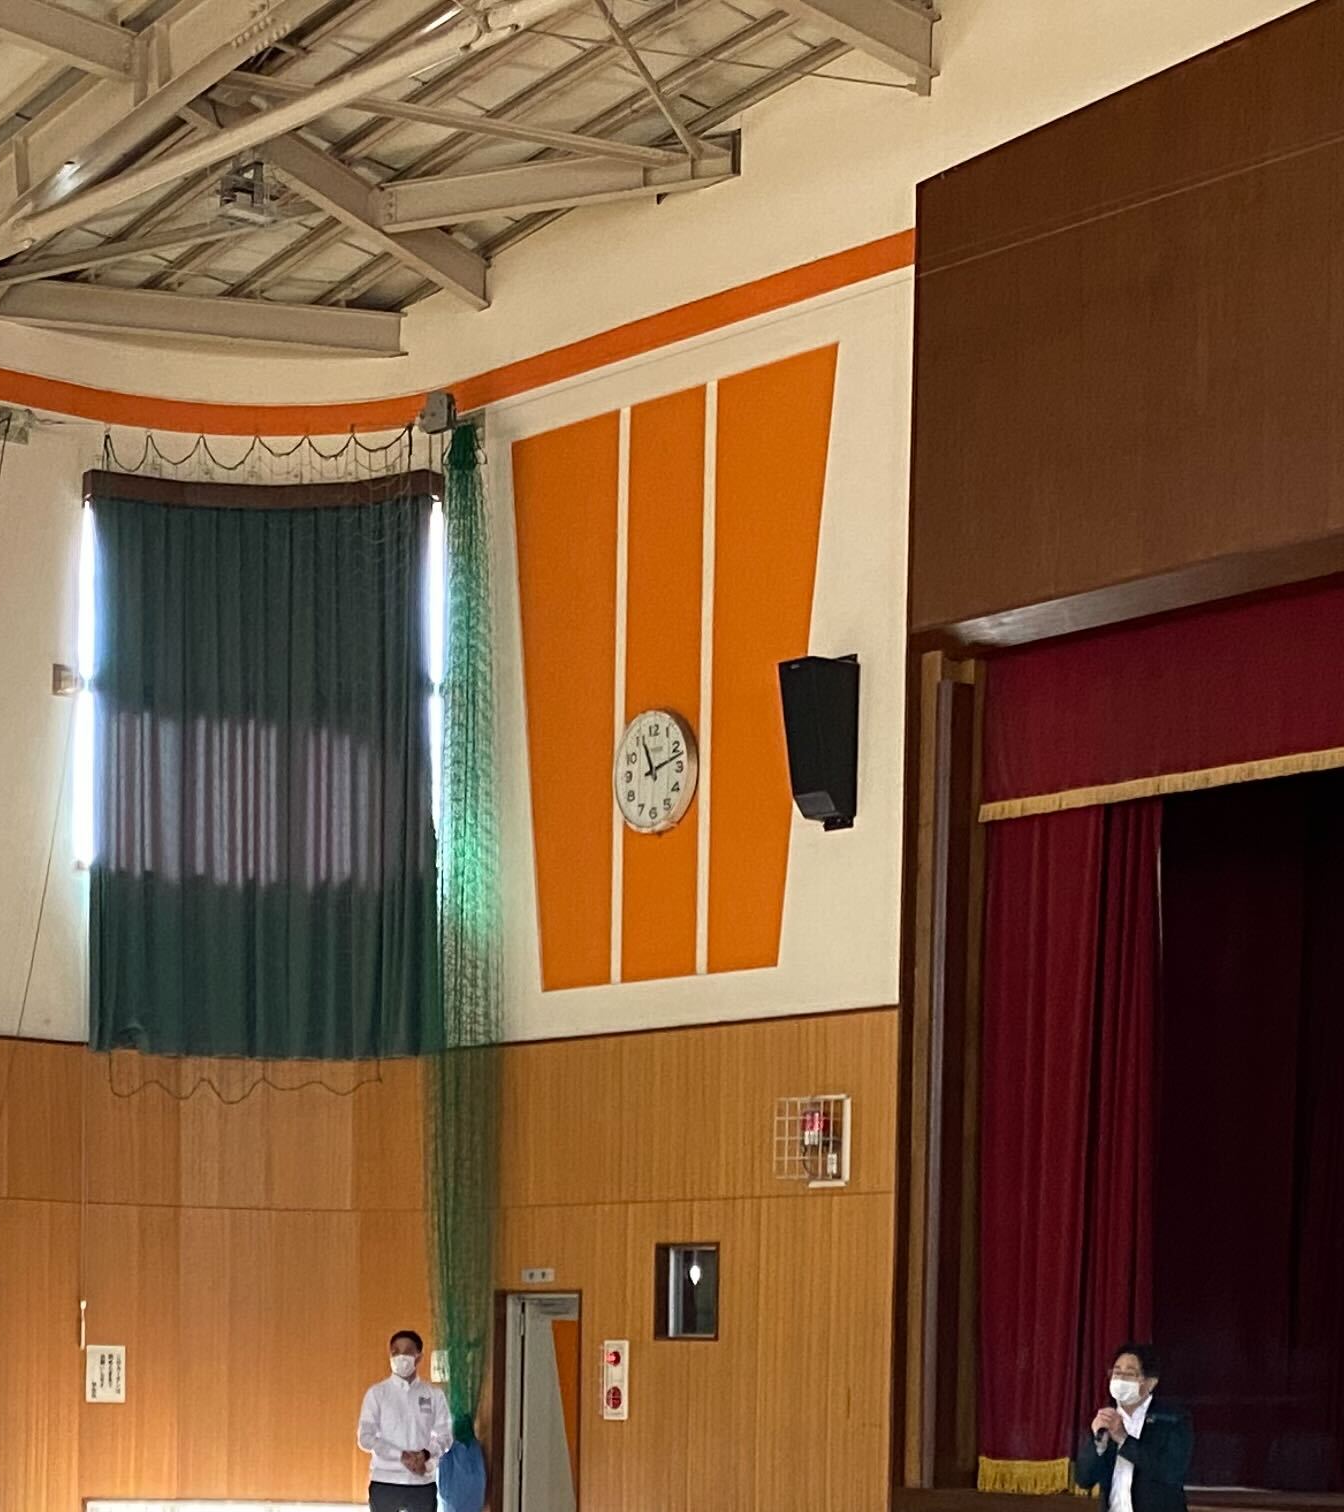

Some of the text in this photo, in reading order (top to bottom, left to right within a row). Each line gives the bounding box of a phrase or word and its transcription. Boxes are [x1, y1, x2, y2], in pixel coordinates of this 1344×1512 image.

[649, 724, 660, 737] 12
[666, 726, 670, 738] 1
[672, 741, 680, 753] 2
[627, 751, 637, 765] 10
[675, 760, 684, 773] 3
[624, 771, 633, 783] 9
[671, 781, 680, 792] 4
[627, 790, 635, 802] 8
[637, 803, 645, 816] 7
[663, 798, 672, 811] 5
[649, 807, 658, 819] 6
